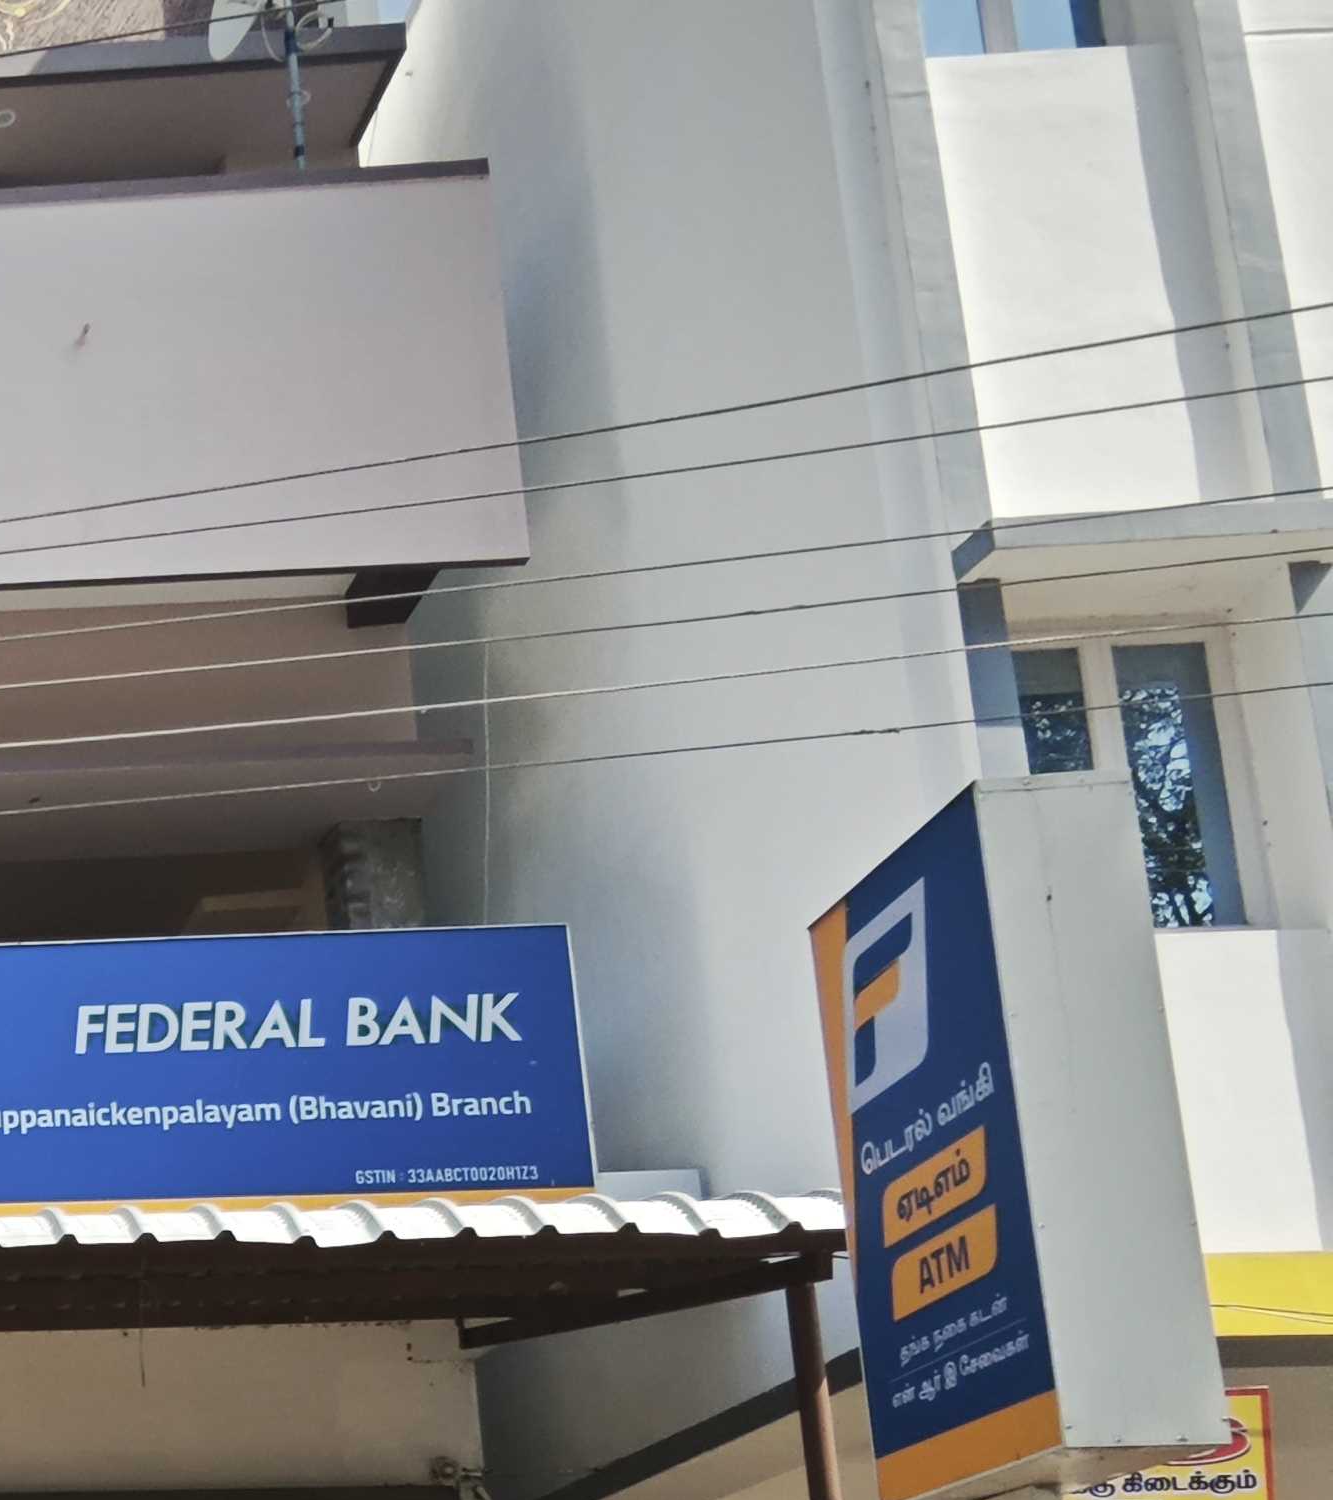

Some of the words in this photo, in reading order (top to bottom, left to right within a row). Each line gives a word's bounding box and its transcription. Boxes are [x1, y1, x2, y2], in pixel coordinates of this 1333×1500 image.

[75, 998, 326, 1056] FEDERAL
[346, 992, 522, 1047] BANK
[289, 1091, 423, 1125] (Bhavani)
[431, 1089, 532, 1119] Branch
[861, 1108, 933, 1175] பெடரல்
[937, 1062, 995, 1126] வங்கி
[355, 1169, 396, 1185] GSTIN
[896, 1149, 971, 1222] ஏடிஎம்
[919, 1236, 971, 1294] ATM
[1121, 1468, 1258, 1495] கிடைக்கும்
